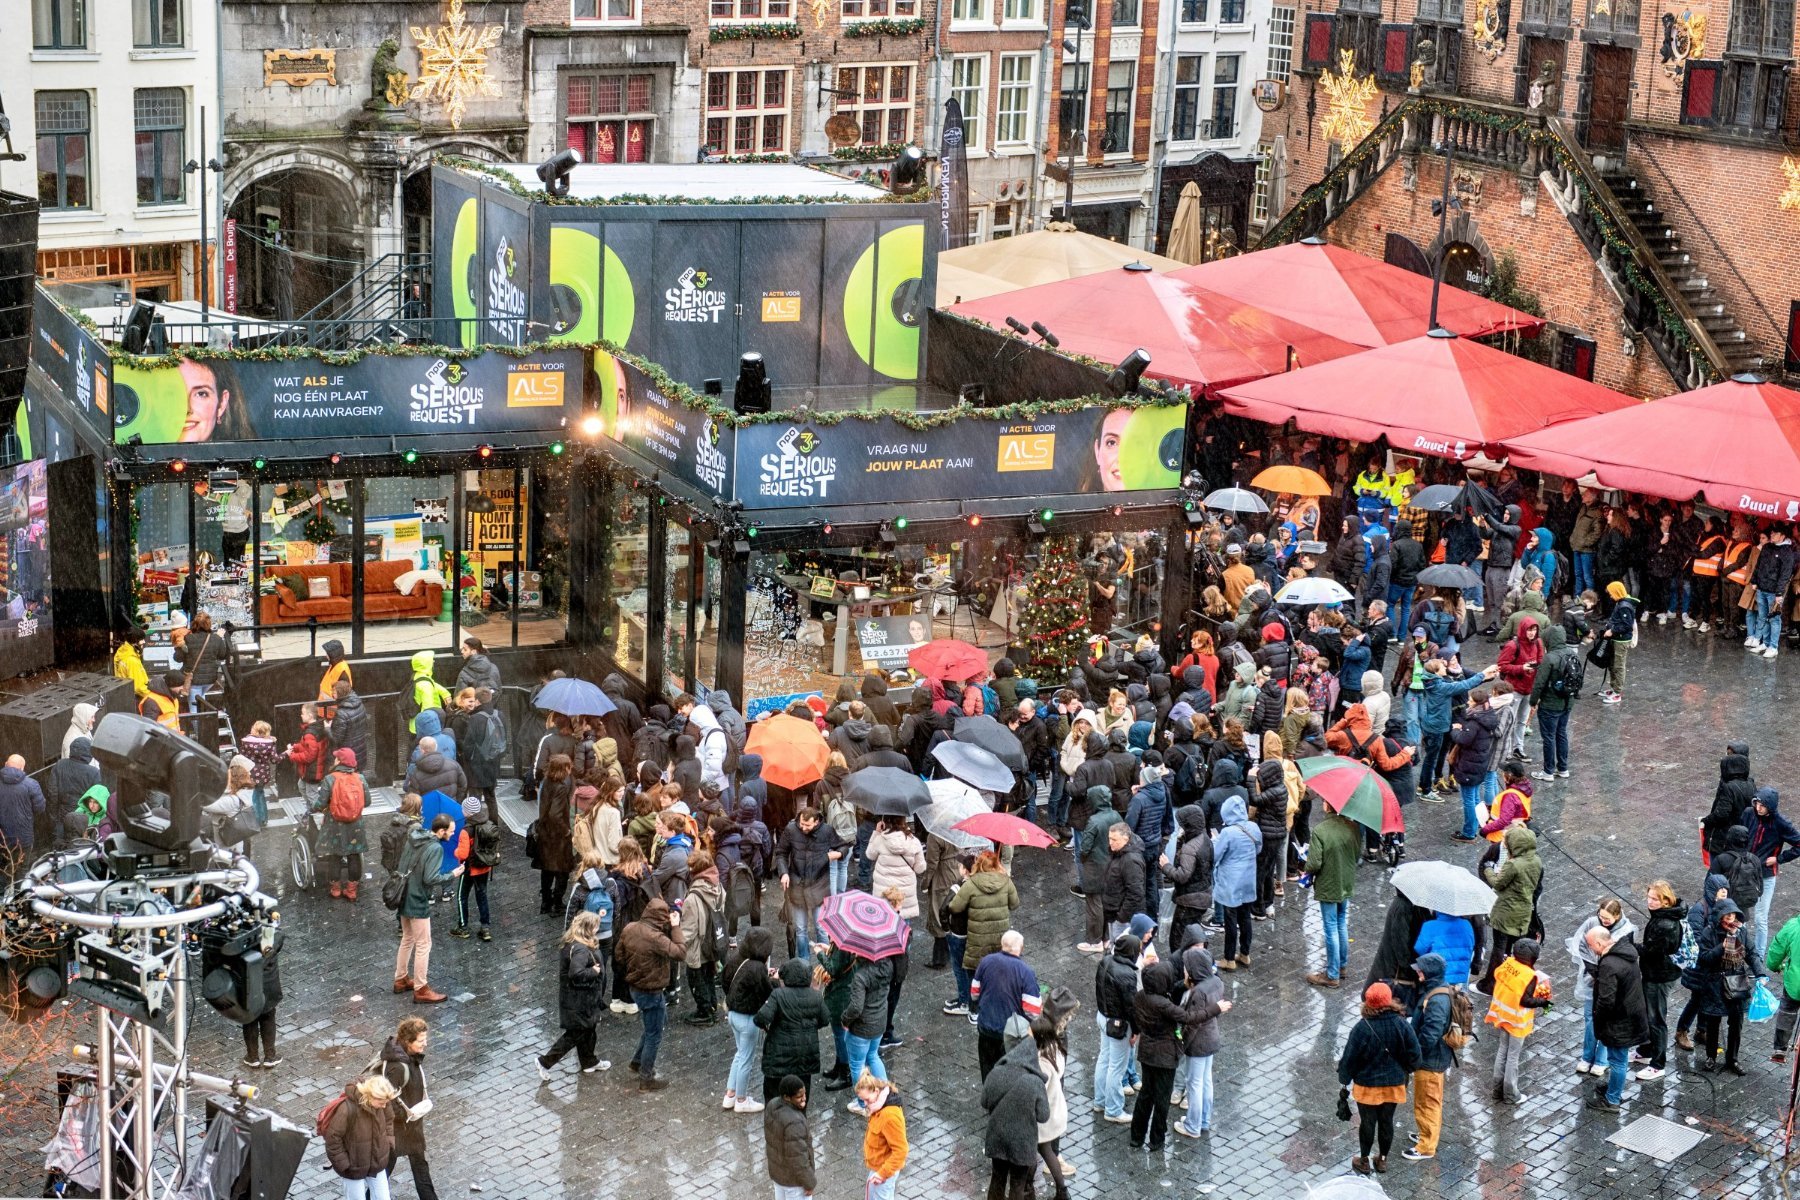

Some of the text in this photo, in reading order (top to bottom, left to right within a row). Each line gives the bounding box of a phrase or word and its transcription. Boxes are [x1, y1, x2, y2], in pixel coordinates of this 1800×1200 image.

[227, 221, 236, 247] Bruijn
[227, 249, 235, 261] De
[680, 269, 693, 284] npo
[489, 268, 525, 316] SERIOUS
[665, 287, 726, 310] SERIOUS
[665, 305, 725, 323] REQUEST
[766, 301, 797, 314] ALS
[428, 361, 444, 378] npo
[517, 363, 541, 371] ACTIE
[274, 375, 344, 388] WAT ALS JE
[514, 377, 558, 396] ALS
[274, 389, 368, 403] NOG ÉÉN PLAAT
[410, 384, 484, 410] SERIOUS
[274, 405, 384, 419] KAN AANVRAGEN?
[410, 403, 483, 425] REQUEST
[779, 428, 797, 448] npo
[1009, 425, 1032, 433] ACTIE
[1033, 424, 1056, 432] VOOR
[696, 435, 727, 472] SERIOUS
[867, 443, 927, 455] VRAAG NU
[1003, 439, 1048, 460] ALS
[1414, 435, 1449, 454] Duvel
[760, 454, 836, 481] SERIOUS
[866, 457, 974, 472] JOUW PLAAT AAN!
[695, 463, 726, 494] REQUEST
[760, 475, 835, 498] REQUEST
[1739, 494, 1780, 515] Duvel
[479, 511, 510, 524] KOMT
